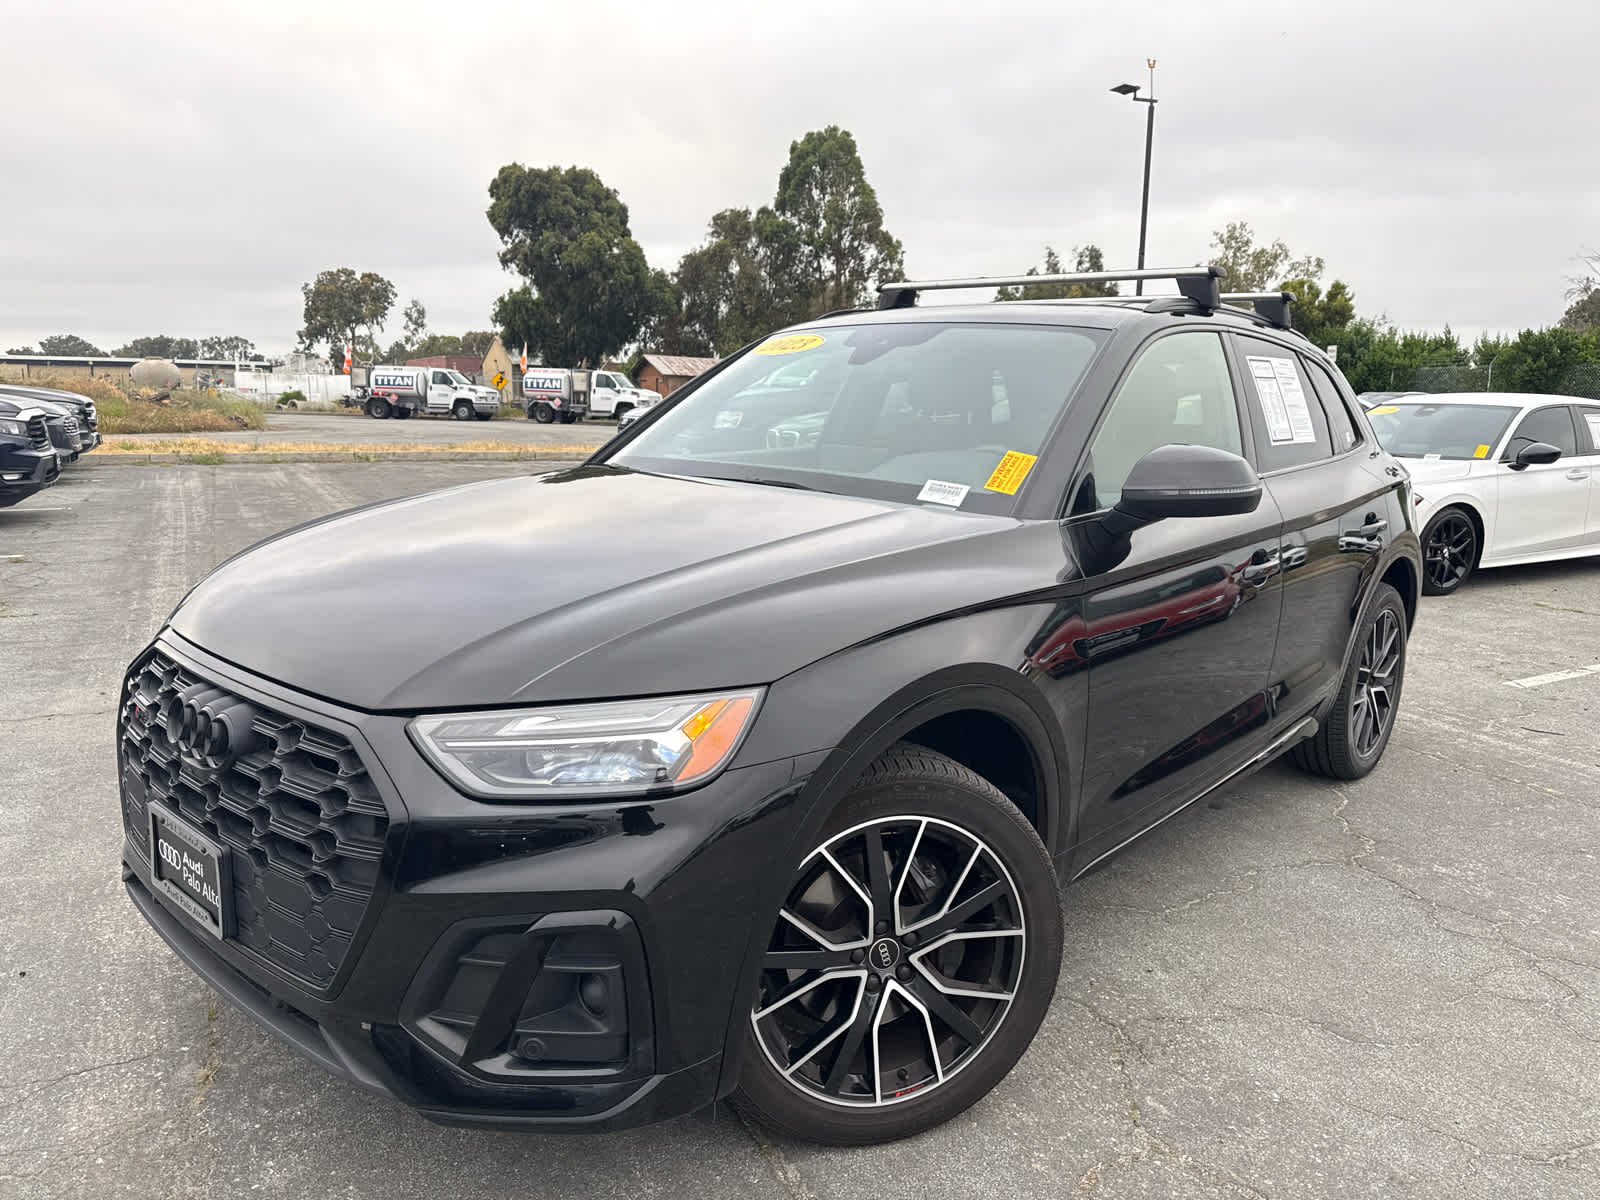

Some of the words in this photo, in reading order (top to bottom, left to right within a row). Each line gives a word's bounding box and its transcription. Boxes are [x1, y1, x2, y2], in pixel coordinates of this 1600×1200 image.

[375, 376, 413, 386] TITAN
[526, 379, 561, 389] TITAN
[995, 453, 1013, 474] VEHICLE
[182, 850, 204, 877] Audi
[183, 866, 201, 893] Palo
